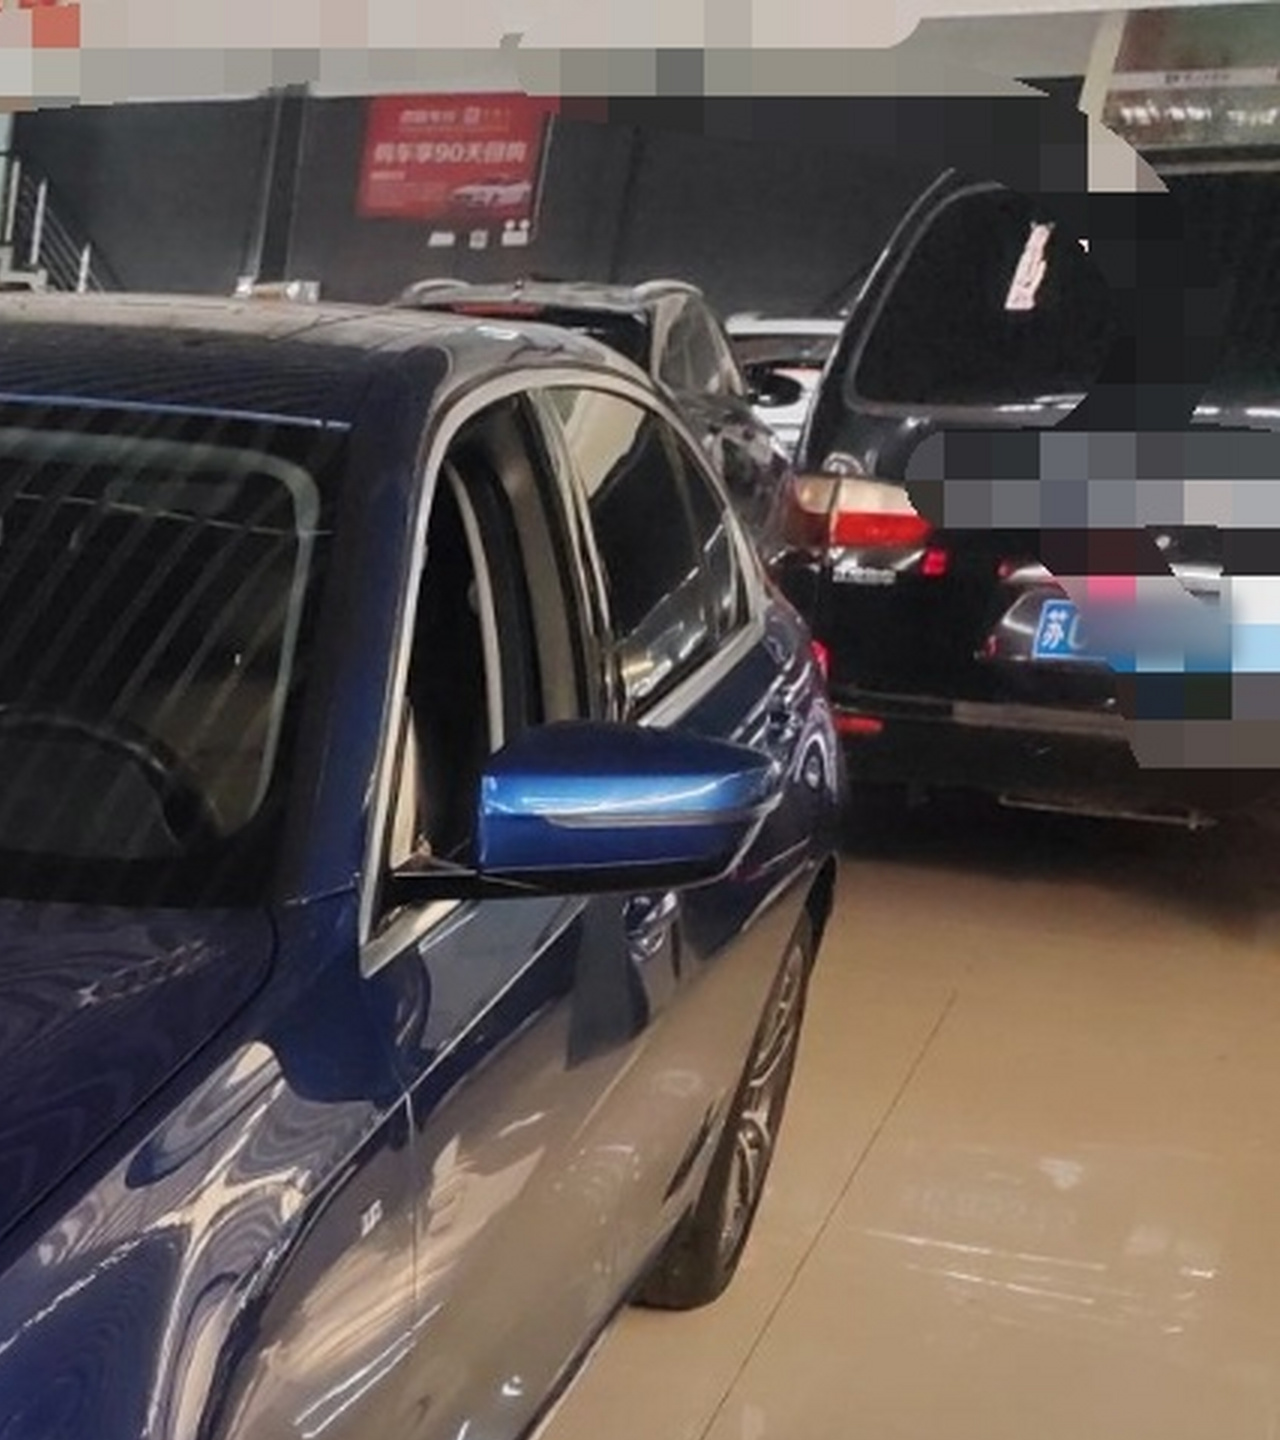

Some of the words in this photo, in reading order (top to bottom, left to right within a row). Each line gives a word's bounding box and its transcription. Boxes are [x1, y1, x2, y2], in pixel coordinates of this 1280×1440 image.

[374, 141, 528, 164] 购车享90天回购
